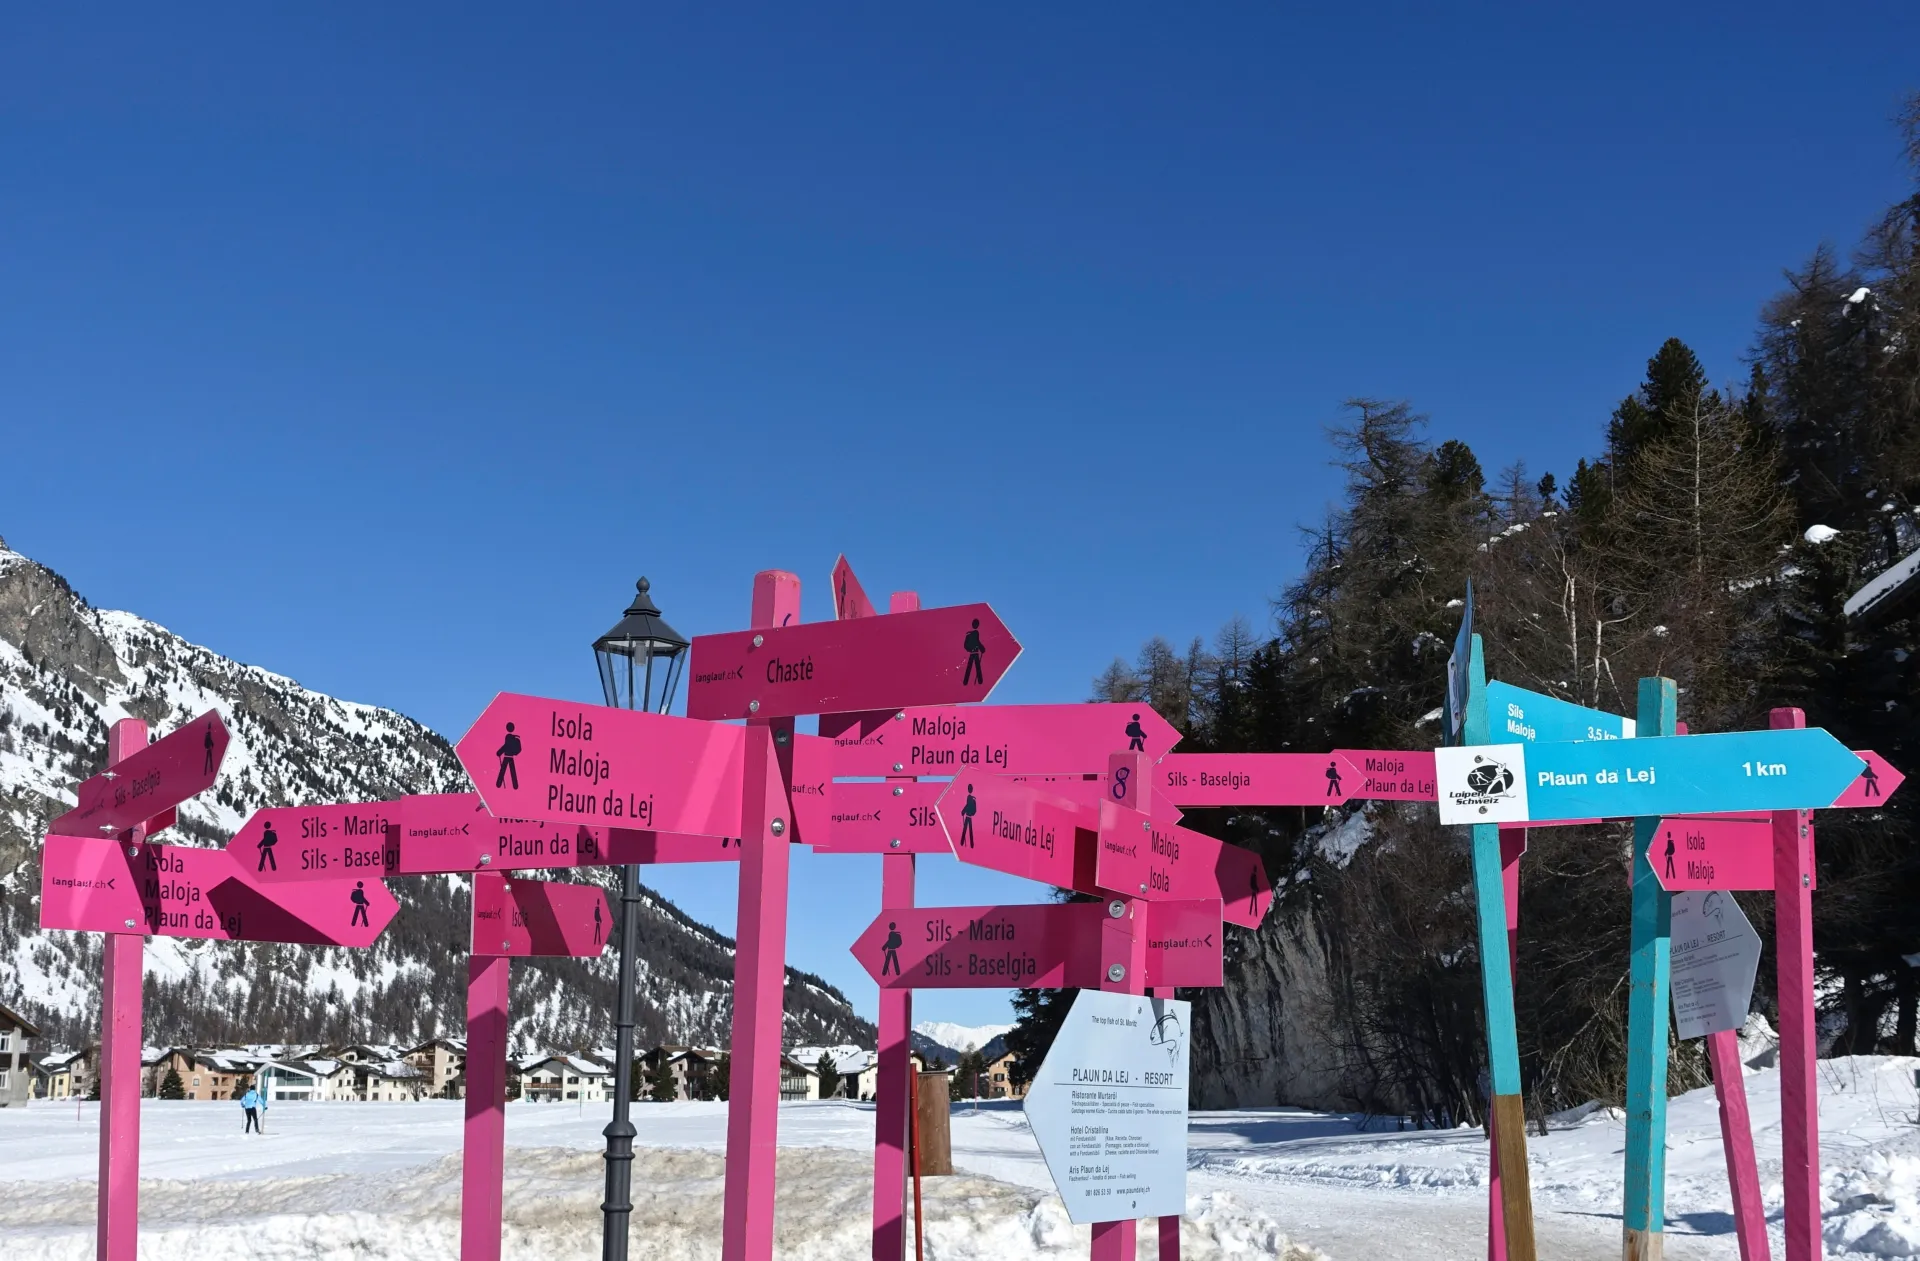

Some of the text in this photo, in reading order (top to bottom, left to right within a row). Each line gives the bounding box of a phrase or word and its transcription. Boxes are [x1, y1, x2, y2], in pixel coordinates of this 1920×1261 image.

[696, 655, 814, 684] langlauf.ch Chastè
[1508, 703, 1524, 719] Sils
[551, 711, 593, 742] Isola
[912, 717, 966, 740] Maloja
[1507, 719, 1536, 740] Maloja
[1587, 726, 1602, 742] 3,5
[834, 738, 876, 747] nglauf.ch
[550, 747, 610, 785] Maloja
[911, 744, 1008, 769] Plaun da Lej
[1365, 757, 1405, 773] Maloja
[1112, 767, 1131, 800] 8
[1167, 772, 1188, 787] Sils
[1200, 771, 1251, 790] Baselgia
[1538, 771, 1588, 787] Plaun
[1595, 769, 1619, 784] da
[1626, 766, 1656, 785] Lej
[114, 786, 126, 808] Sils
[132, 768, 161, 799] Baselgia
[791, 784, 817, 795] auf.ch
[1365, 779, 1434, 797] Plaun da Lej
[1449, 790, 1484, 799] Loipen
[547, 784, 653, 827] Plaun da Lej
[1455, 797, 1500, 806] Schweiz
[301, 817, 328, 839] Sils
[344, 814, 389, 837] Maria
[831, 806, 936, 827] nglauf.ch Sils
[409, 826, 461, 838] langlauf.ch
[992, 810, 1055, 858] Plaun da Lej
[1686, 832, 1706, 852] Isola
[499, 832, 599, 859] Plaun da Lej
[1104, 840, 1133, 857] langlauf.ch
[1151, 831, 1180, 863] Maloja
[146, 852, 184, 873] Isola
[301, 849, 328, 870] Sils
[344, 845, 400, 875] Baselgi
[52, 877, 106, 889] langlauf.ch
[1149, 866, 1170, 893] Isola
[1687, 860, 1715, 885] Maloja
[145, 879, 201, 906] Maloja
[144, 906, 242, 936] Plaun da Lej
[511, 907, 529, 928] Isola
[926, 920, 952, 942] Sils
[969, 919, 1015, 941] Maria
[1148, 937, 1203, 951] langlauf.ch
[925, 954, 952, 976] Sils
[968, 953, 1036, 982] Baselgia
[1072, 1068, 1100, 1082] PLAUN
[1102, 1069, 1113, 1083] DA
[1115, 1070, 1129, 1084] LEJ
[1144, 1071, 1174, 1085] RESORT
[1070, 1125, 1084, 1135] Hotel
[1080, 1165, 1094, 1174] Plaun
[1094, 1165, 1101, 1173] da
[1102, 1164, 1110, 1174] Lej
